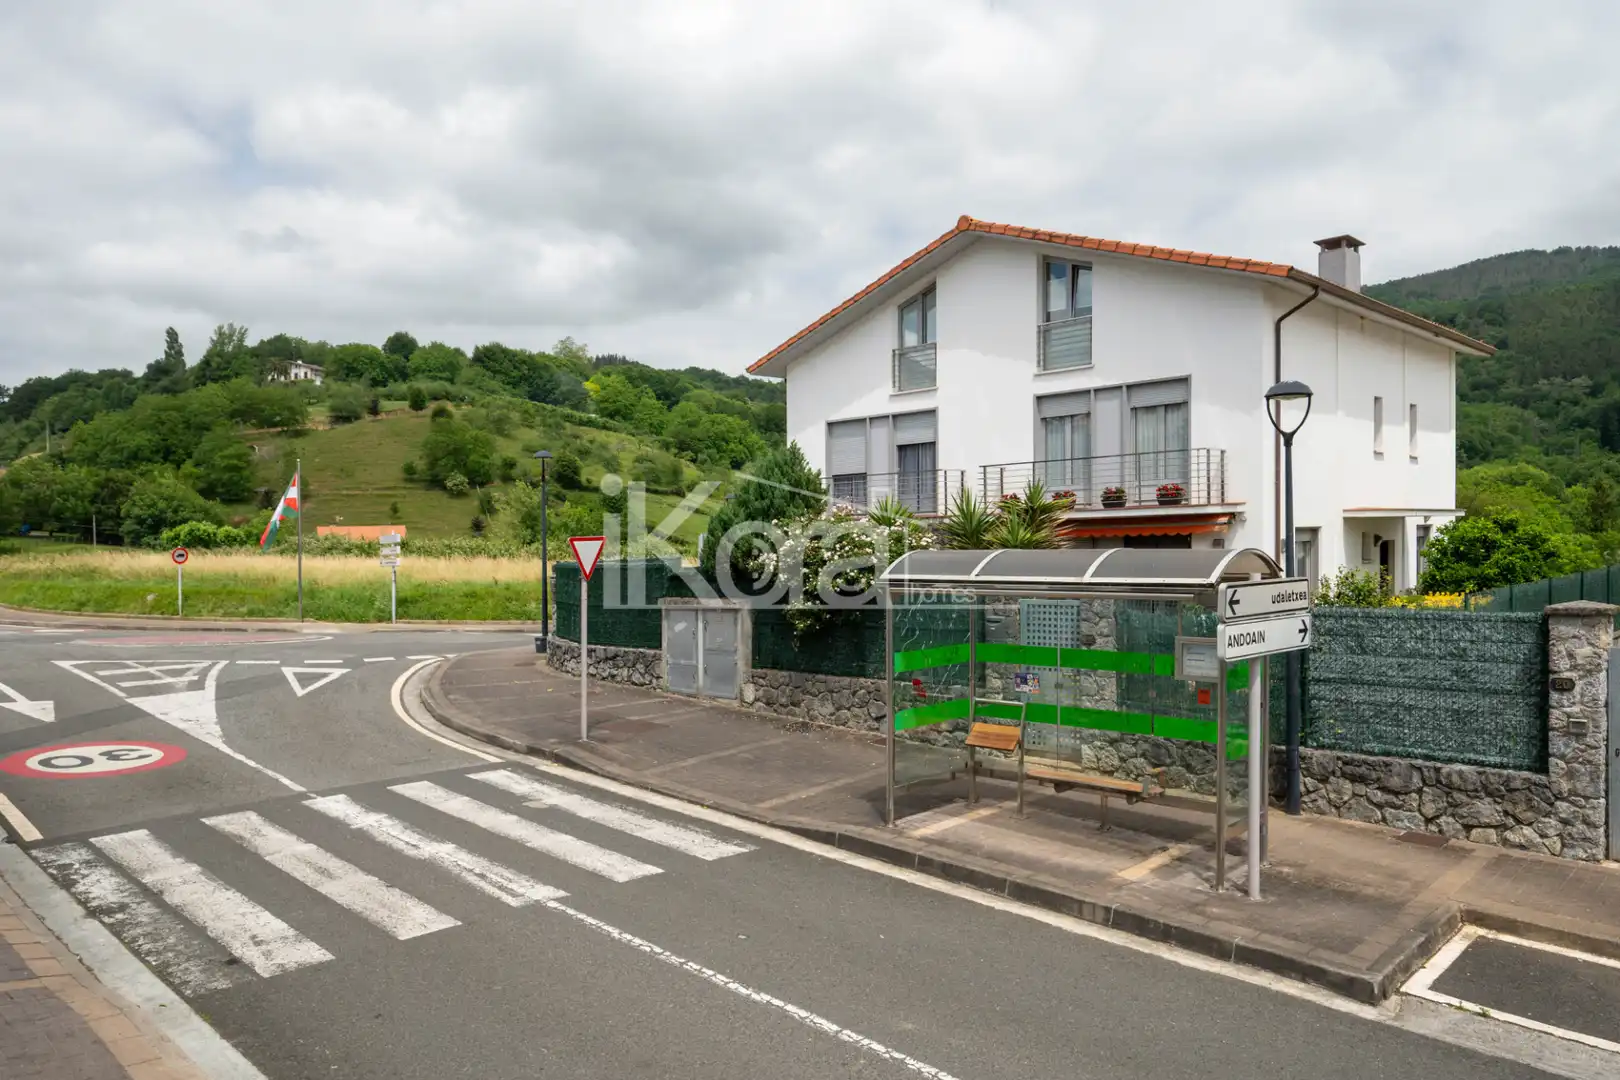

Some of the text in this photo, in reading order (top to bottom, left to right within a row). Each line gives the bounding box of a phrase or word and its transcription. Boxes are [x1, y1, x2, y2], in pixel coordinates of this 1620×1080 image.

[1271, 590, 1307, 604] udaletxea
[1227, 630, 1265, 648] ANDOAIN
[38, 749, 153, 769] 30
